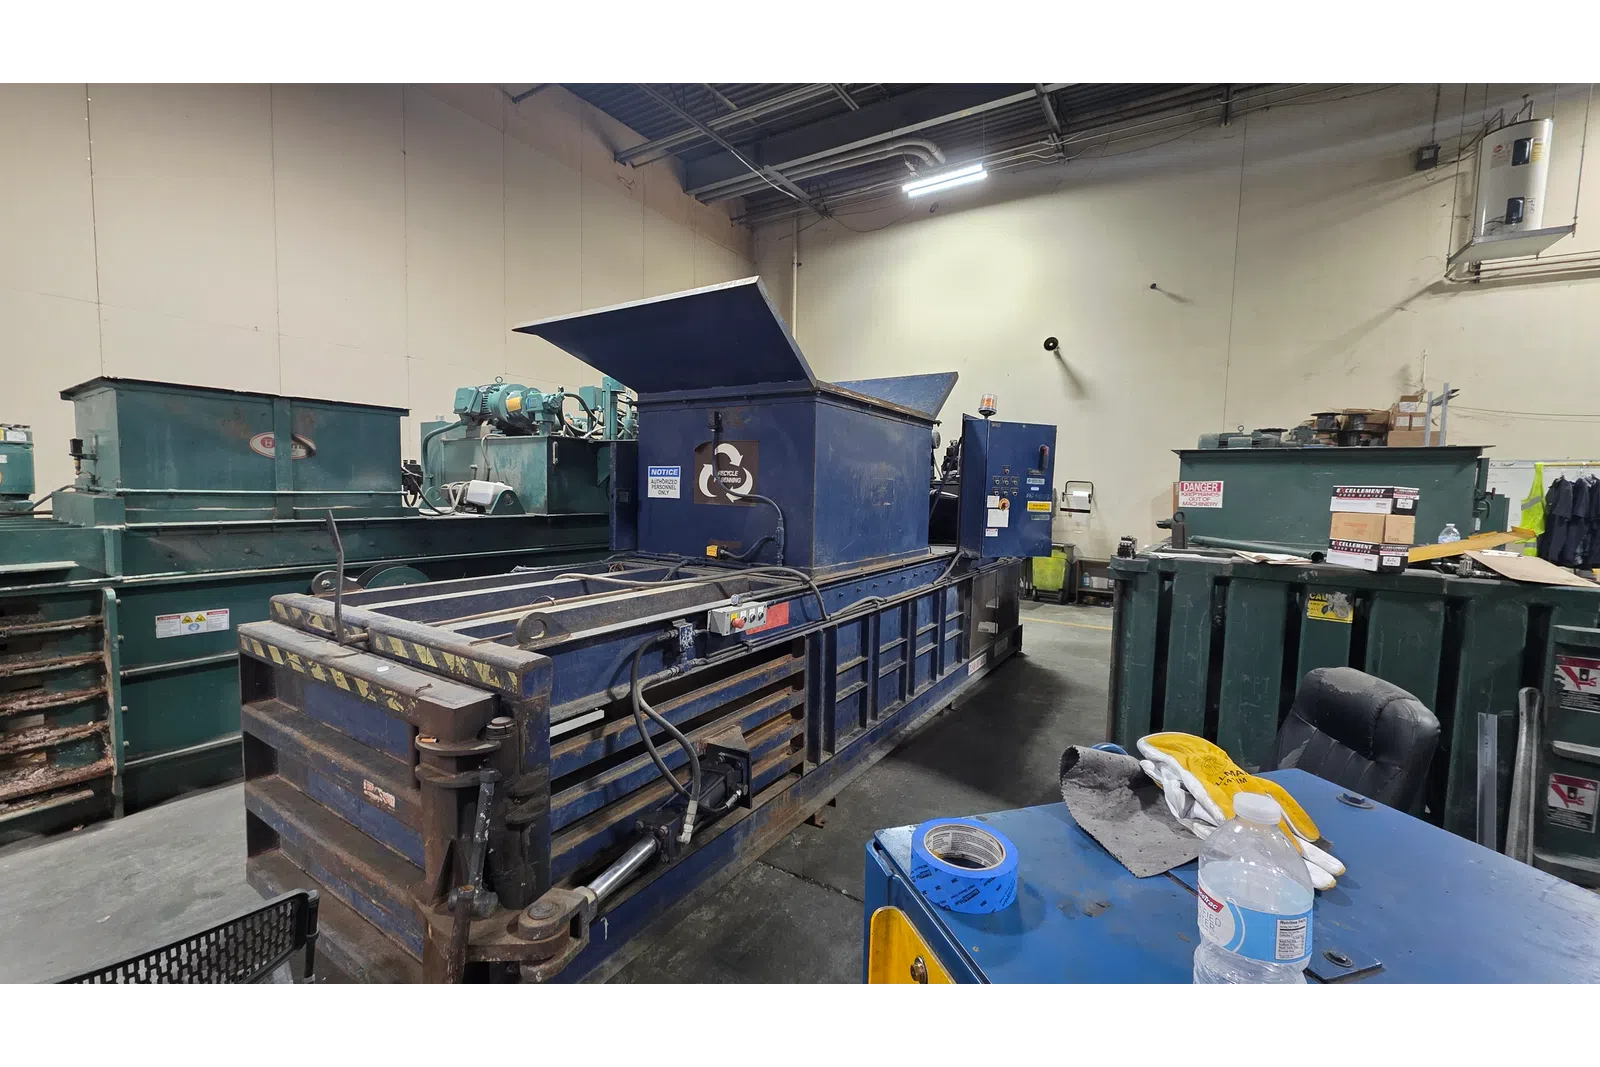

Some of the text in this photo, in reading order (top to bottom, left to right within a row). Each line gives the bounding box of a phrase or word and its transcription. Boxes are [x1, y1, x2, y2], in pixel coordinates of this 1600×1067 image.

[651, 468, 678, 476] NOTICE
[1183, 482, 1218, 492] DANGER
[1331, 540, 1373, 550] EXCELLEMENT
